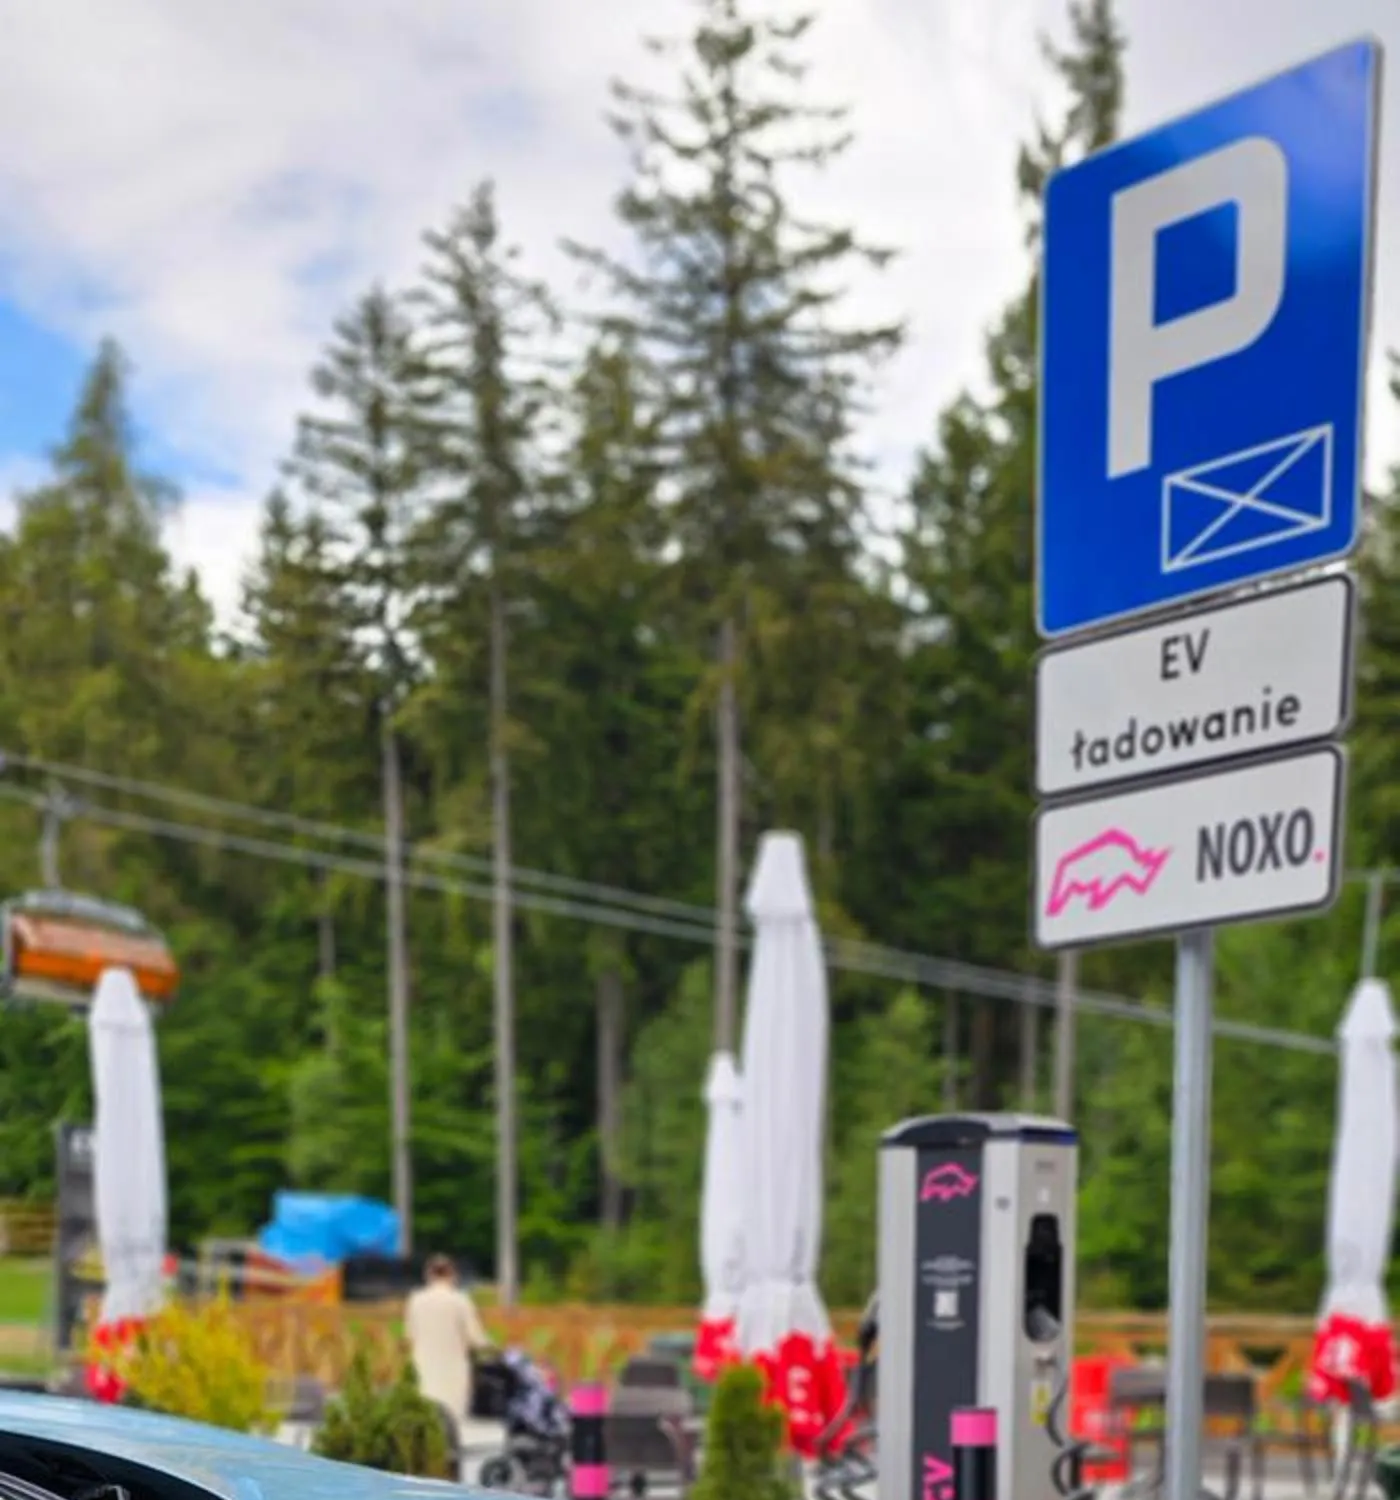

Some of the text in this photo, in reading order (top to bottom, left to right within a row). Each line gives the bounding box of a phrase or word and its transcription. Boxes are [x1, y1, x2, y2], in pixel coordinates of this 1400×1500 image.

[1107, 136, 1288, 480] P
[1159, 627, 1210, 681] EV
[1070, 685, 1301, 771] ładowanie
